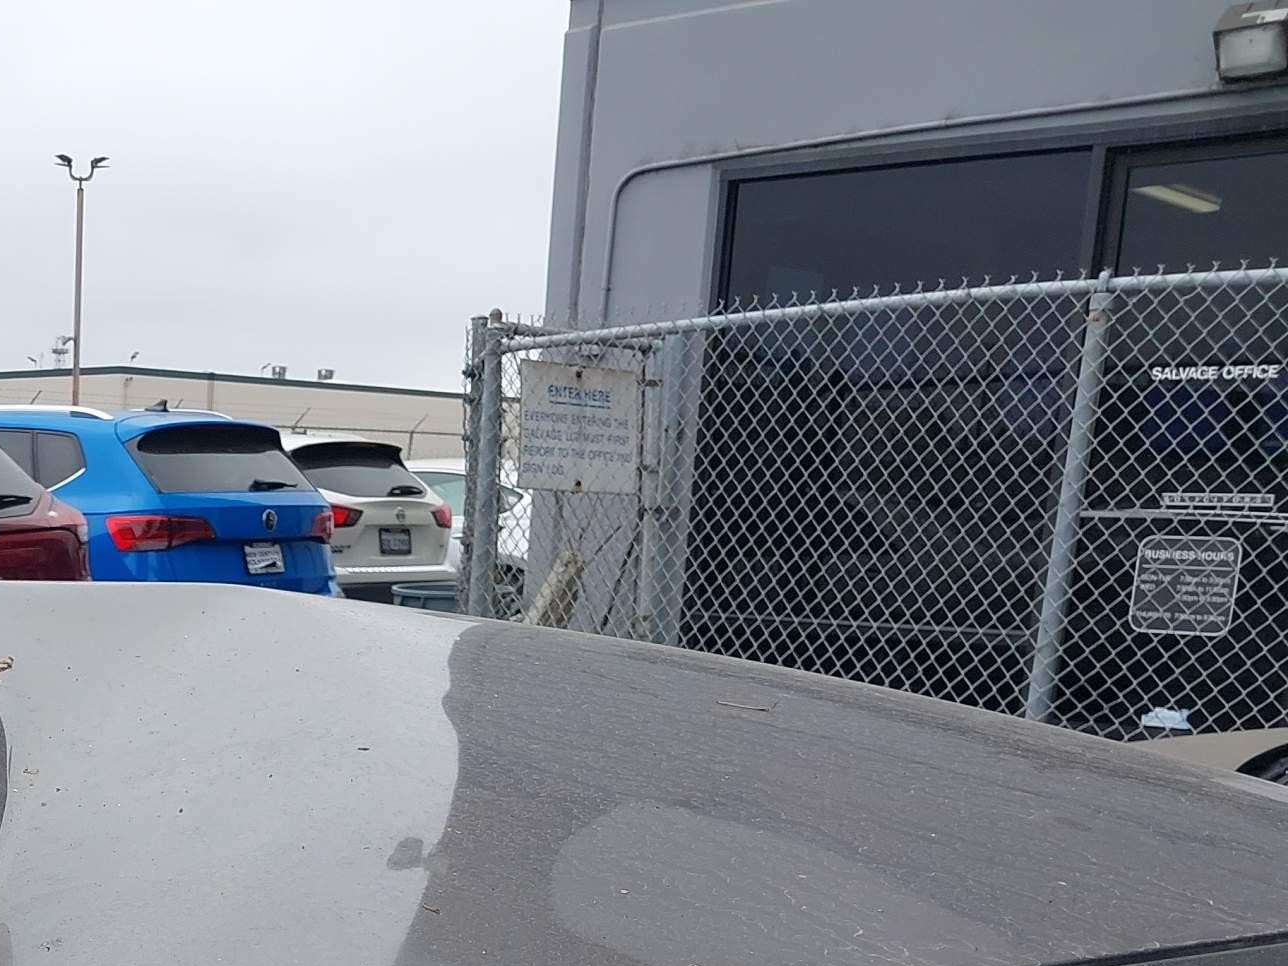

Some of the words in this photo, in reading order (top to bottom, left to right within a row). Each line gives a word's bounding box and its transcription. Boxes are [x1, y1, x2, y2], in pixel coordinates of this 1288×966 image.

[1152, 366, 1220, 380] SALVAGE
[1222, 364, 1281, 380] OFFICE
[547, 384, 582, 400] ENTER
[583, 388, 612, 403] HERE
[1144, 549, 1197, 561] BUSINESS
[1198, 550, 1235, 562] HOURS
